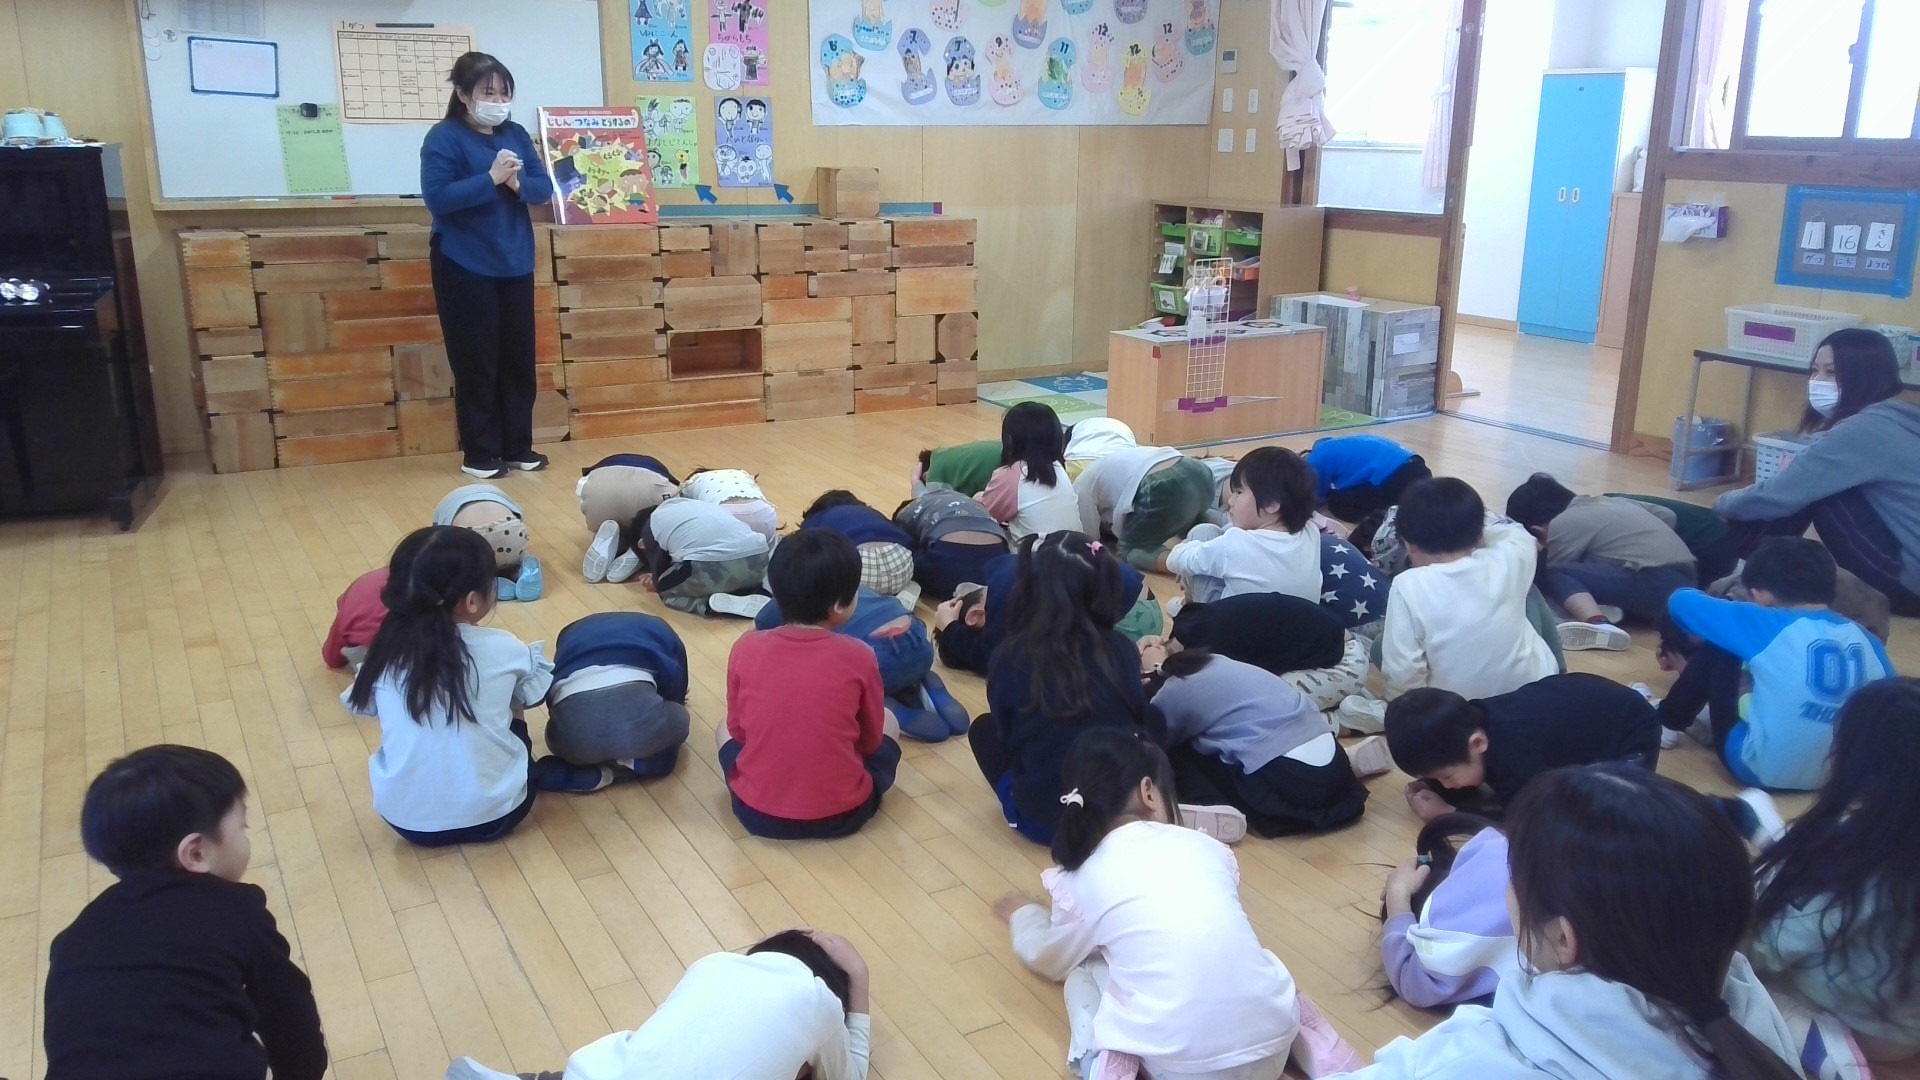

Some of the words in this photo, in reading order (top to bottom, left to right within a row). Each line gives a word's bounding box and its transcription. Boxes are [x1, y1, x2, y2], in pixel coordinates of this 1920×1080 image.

[1098, 23, 1109, 36] 12
[1163, 22, 1173, 35] 12
[717, 33, 752, 43] ちからもち
[1838, 234, 1856, 250] 16
[1874, 228, 1887, 248] きん
[1805, 254, 1823, 263] がつ
[1835, 258, 1852, 266] にち
[1805, 638, 1866, 701] 01
